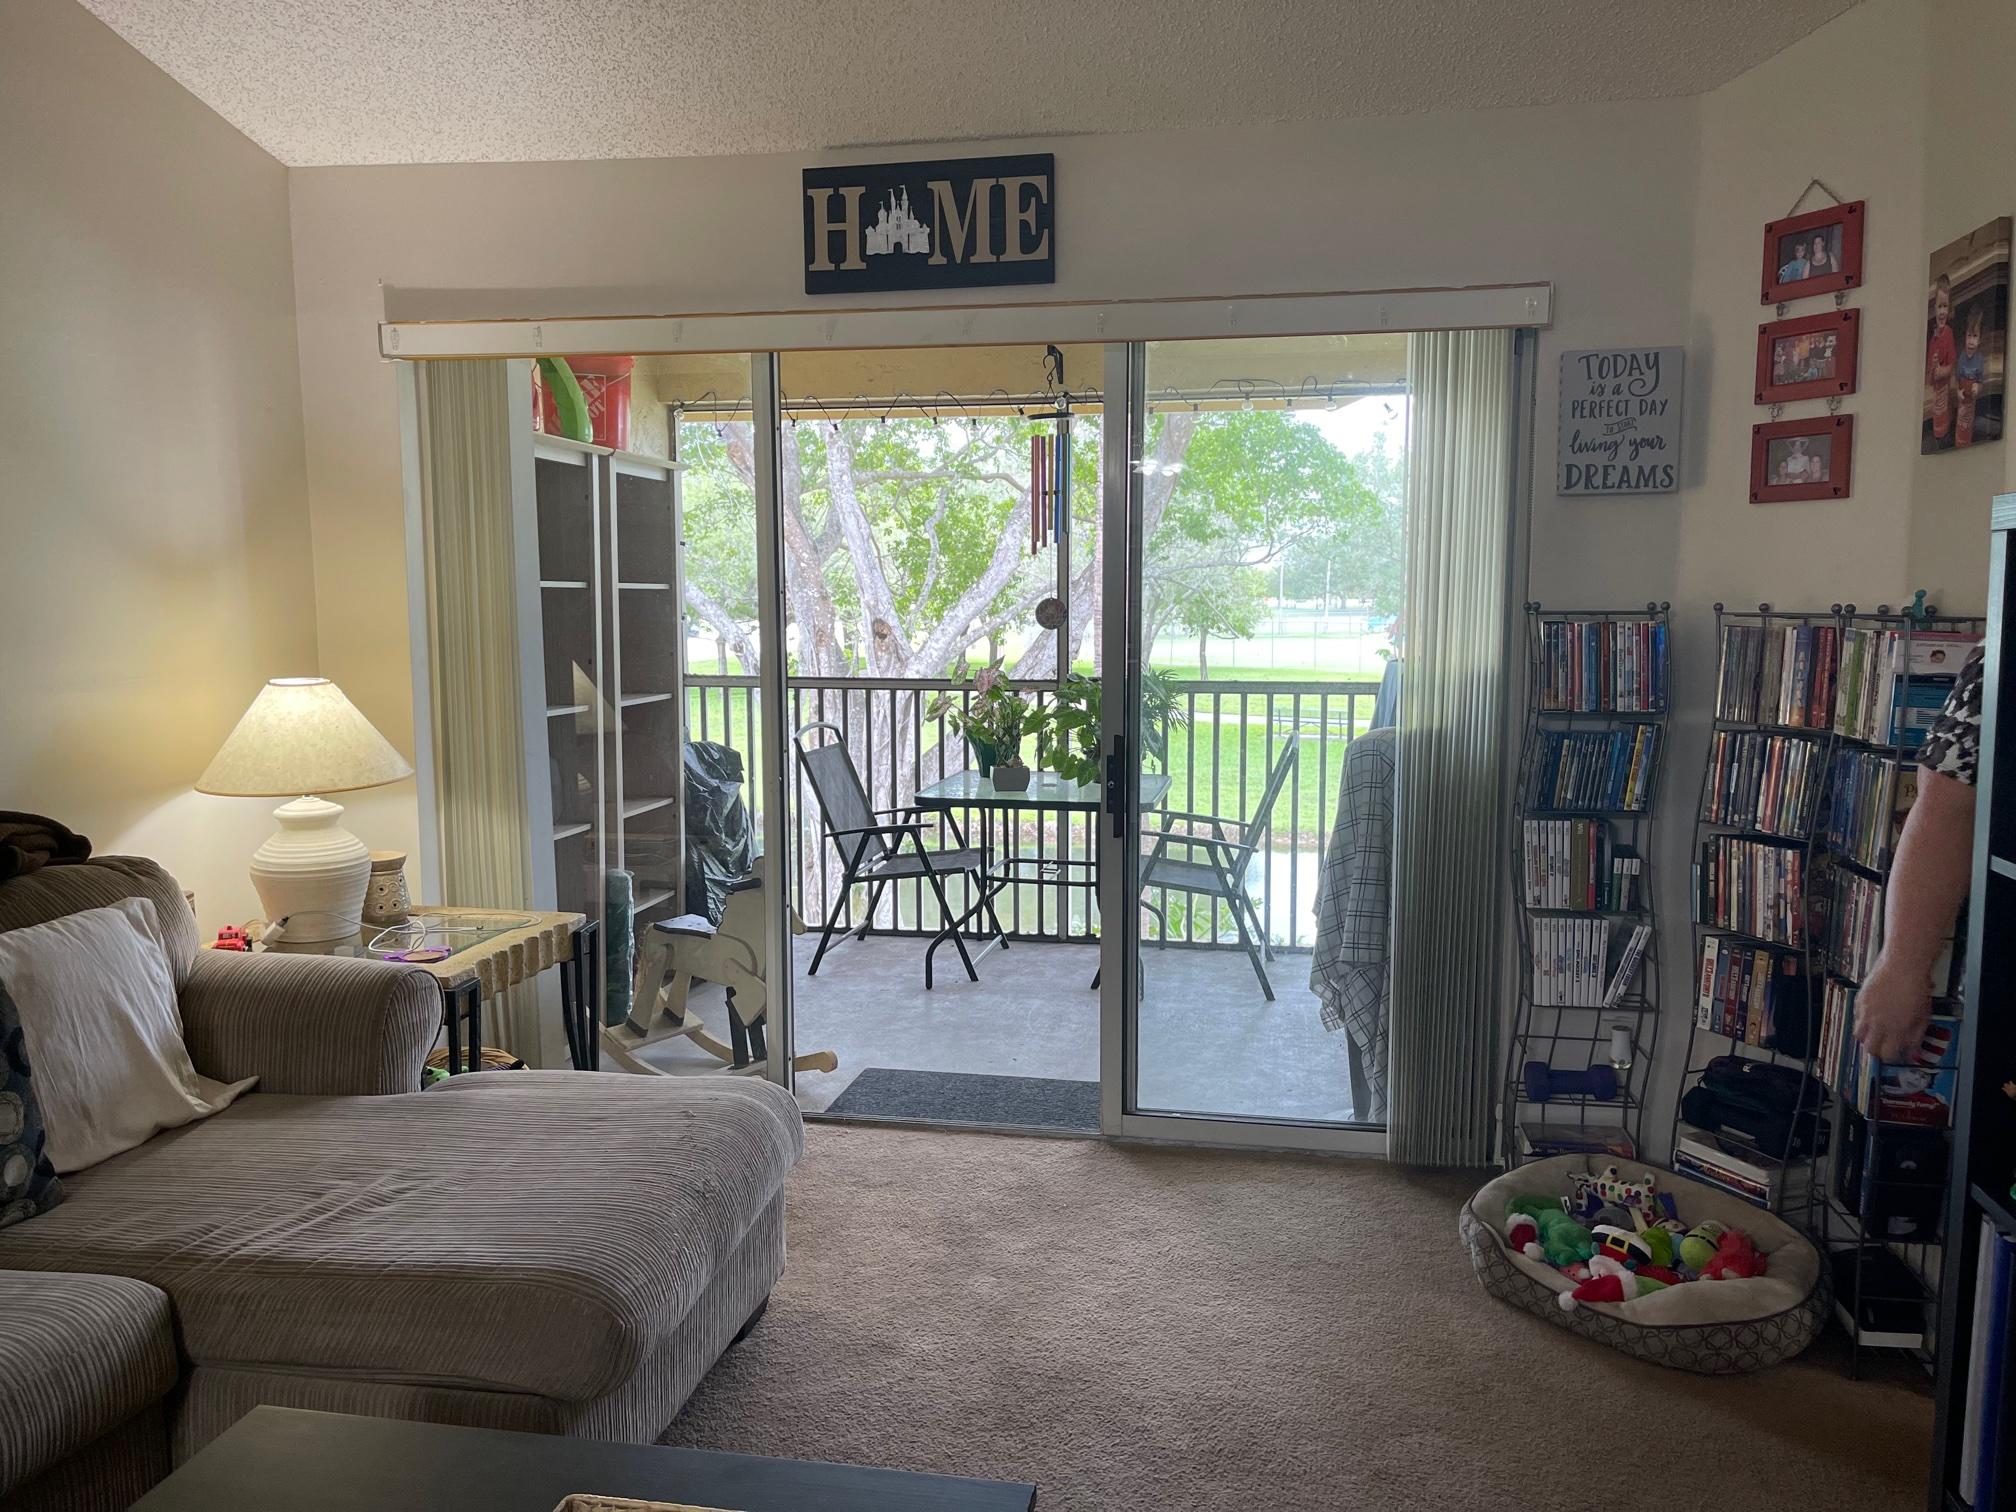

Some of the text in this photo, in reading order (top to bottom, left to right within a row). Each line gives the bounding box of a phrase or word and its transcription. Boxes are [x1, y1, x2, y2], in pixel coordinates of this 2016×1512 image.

[807, 174, 1049, 272] HME
[1578, 351, 1660, 397] TODAY
[1588, 381, 1625, 397] is a
[1571, 398, 1669, 420] PERFECT DAY
[1569, 428, 1667, 462] living your
[1563, 463, 1675, 491] DREAMS
